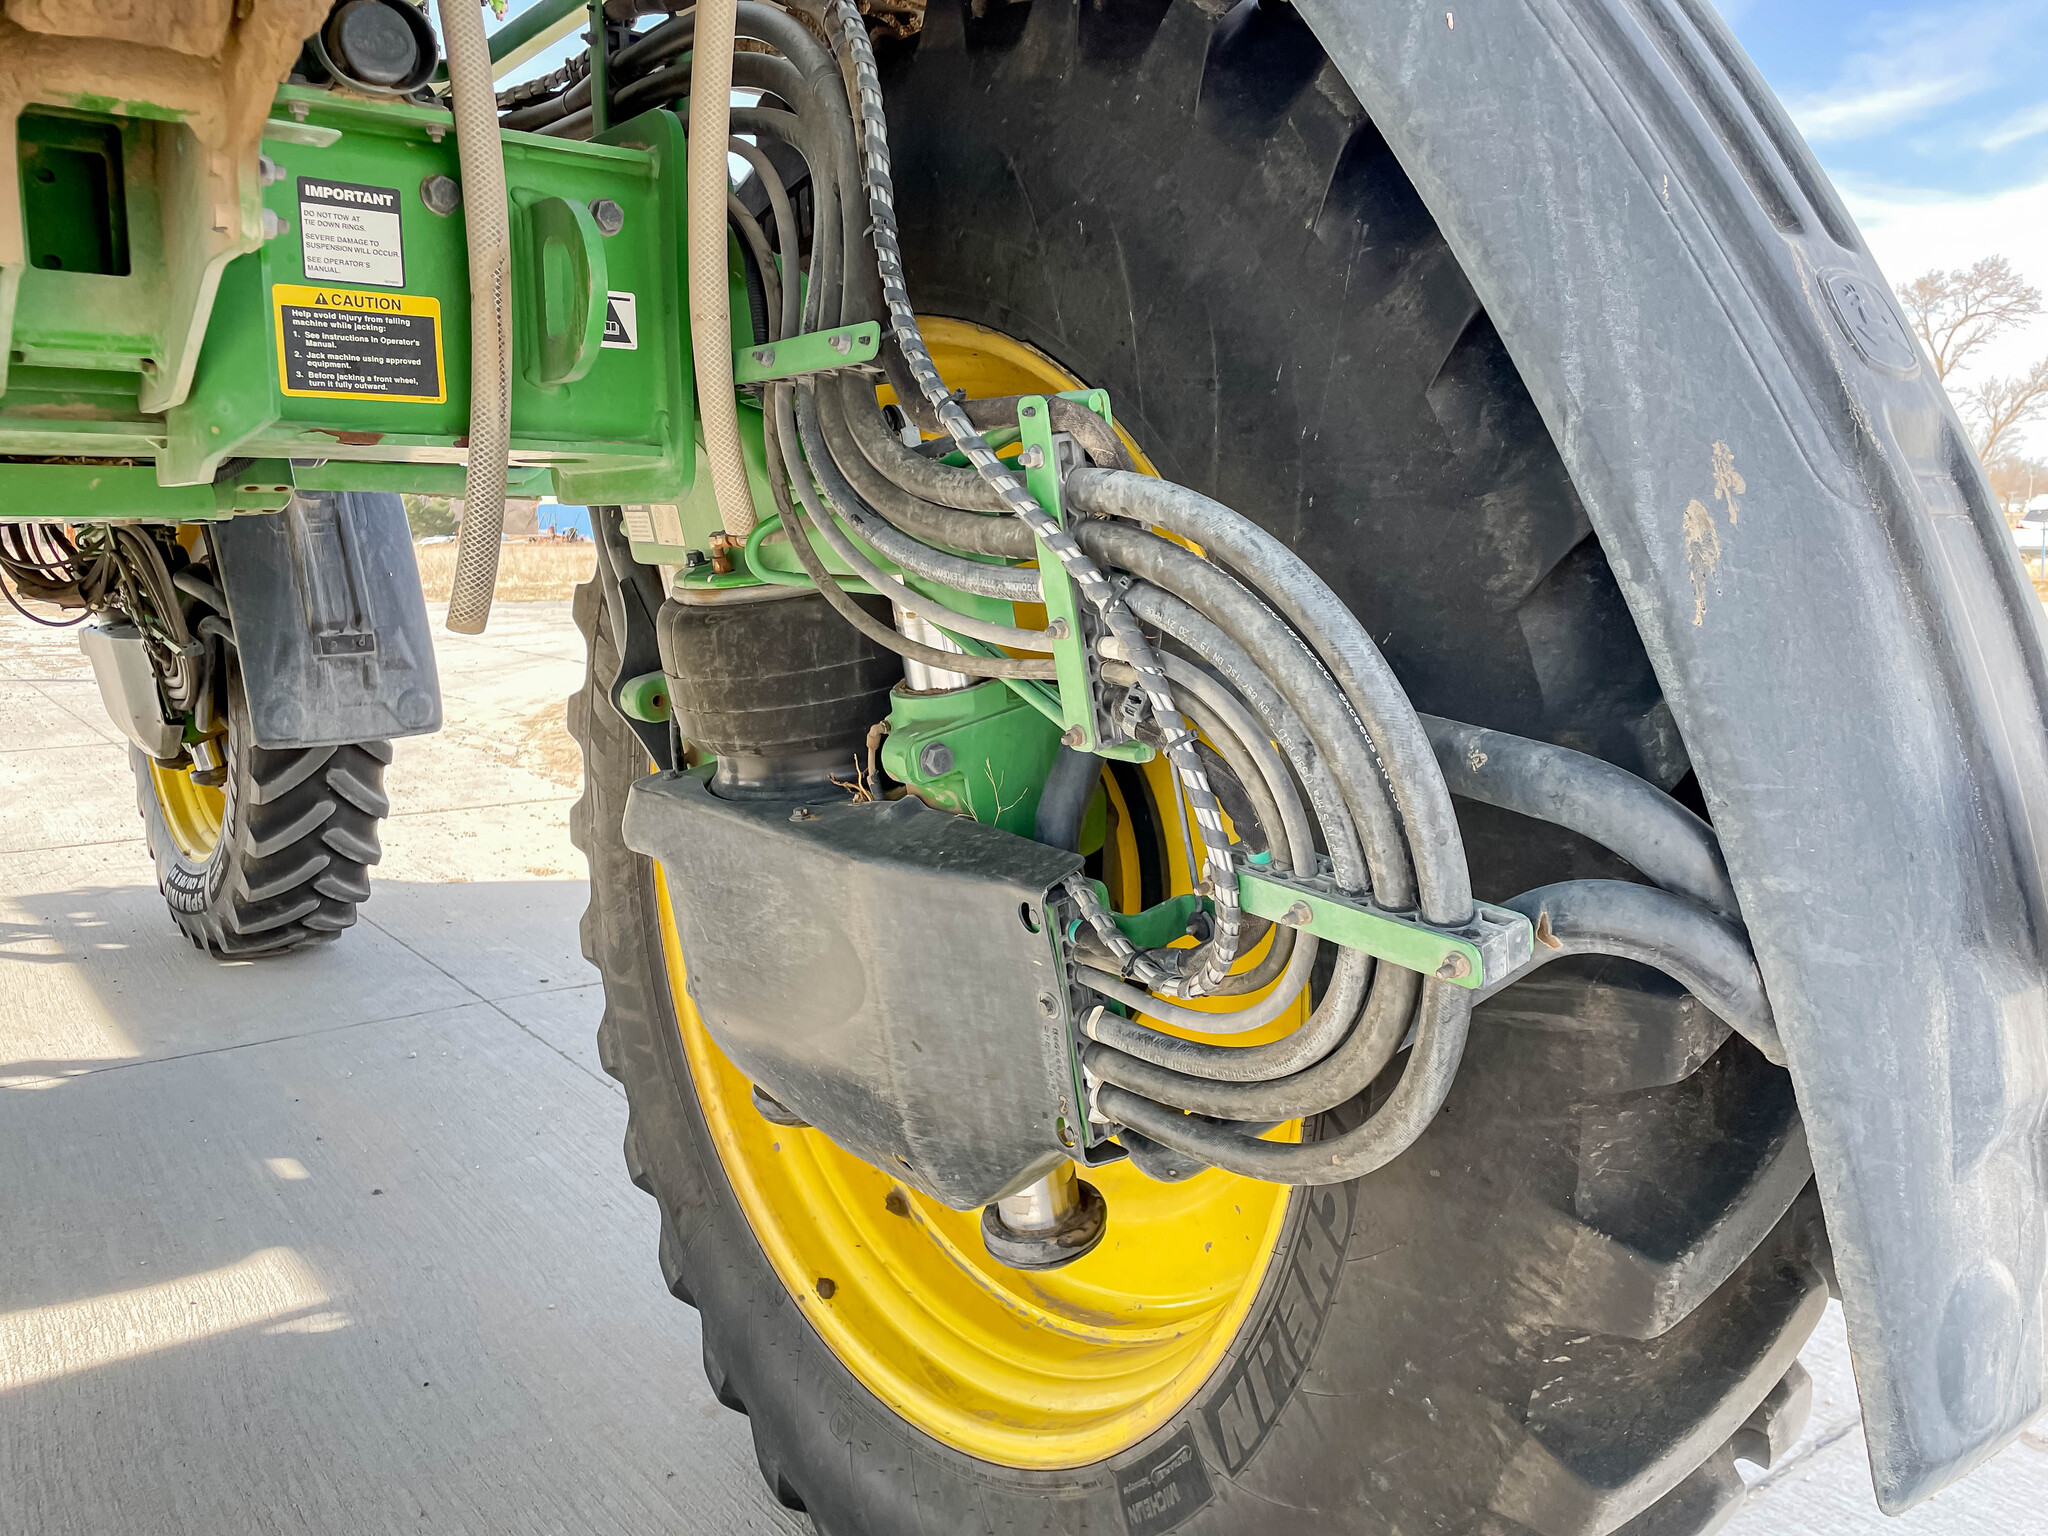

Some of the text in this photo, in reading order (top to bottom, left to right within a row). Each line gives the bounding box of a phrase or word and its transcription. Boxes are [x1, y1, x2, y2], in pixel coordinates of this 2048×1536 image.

[305, 184, 393, 206] IMPORTANT
[318, 220, 340, 228] DOWN
[342, 223, 366, 231] RINGS.
[305, 233, 335, 242] SEVERE
[337, 237, 368, 245] DAMAGE
[306, 242, 352, 252] SUSPENSION
[373, 249, 399, 257] OCCUR.
[308, 265, 341, 273] MANUAL.
[324, 258, 370, 268] OPERATOR'S
[332, 294, 401, 310] CAUTION
[292, 309, 410, 327] Help avoid injury from falling
[292, 319, 386, 332] machine while jacking:
[305, 331, 320, 339] See
[322, 333, 369, 342] instructions
[381, 337, 420, 347] Operator's
[306, 340, 337, 348] Manual.
[307, 361, 351, 369] equipment.
[327, 354, 360, 362] machine
[362, 356, 383, 364] using
[386, 358, 421, 366] approved
[308, 372, 334, 380] Before
[337, 374, 364, 382] jacking
[394, 377, 418, 385] wheel,
[335, 381, 352, 389] fully
[1338, 692, 1376, 753] exceeds
[1127, 1481, 1181, 1526] MICHELIN
